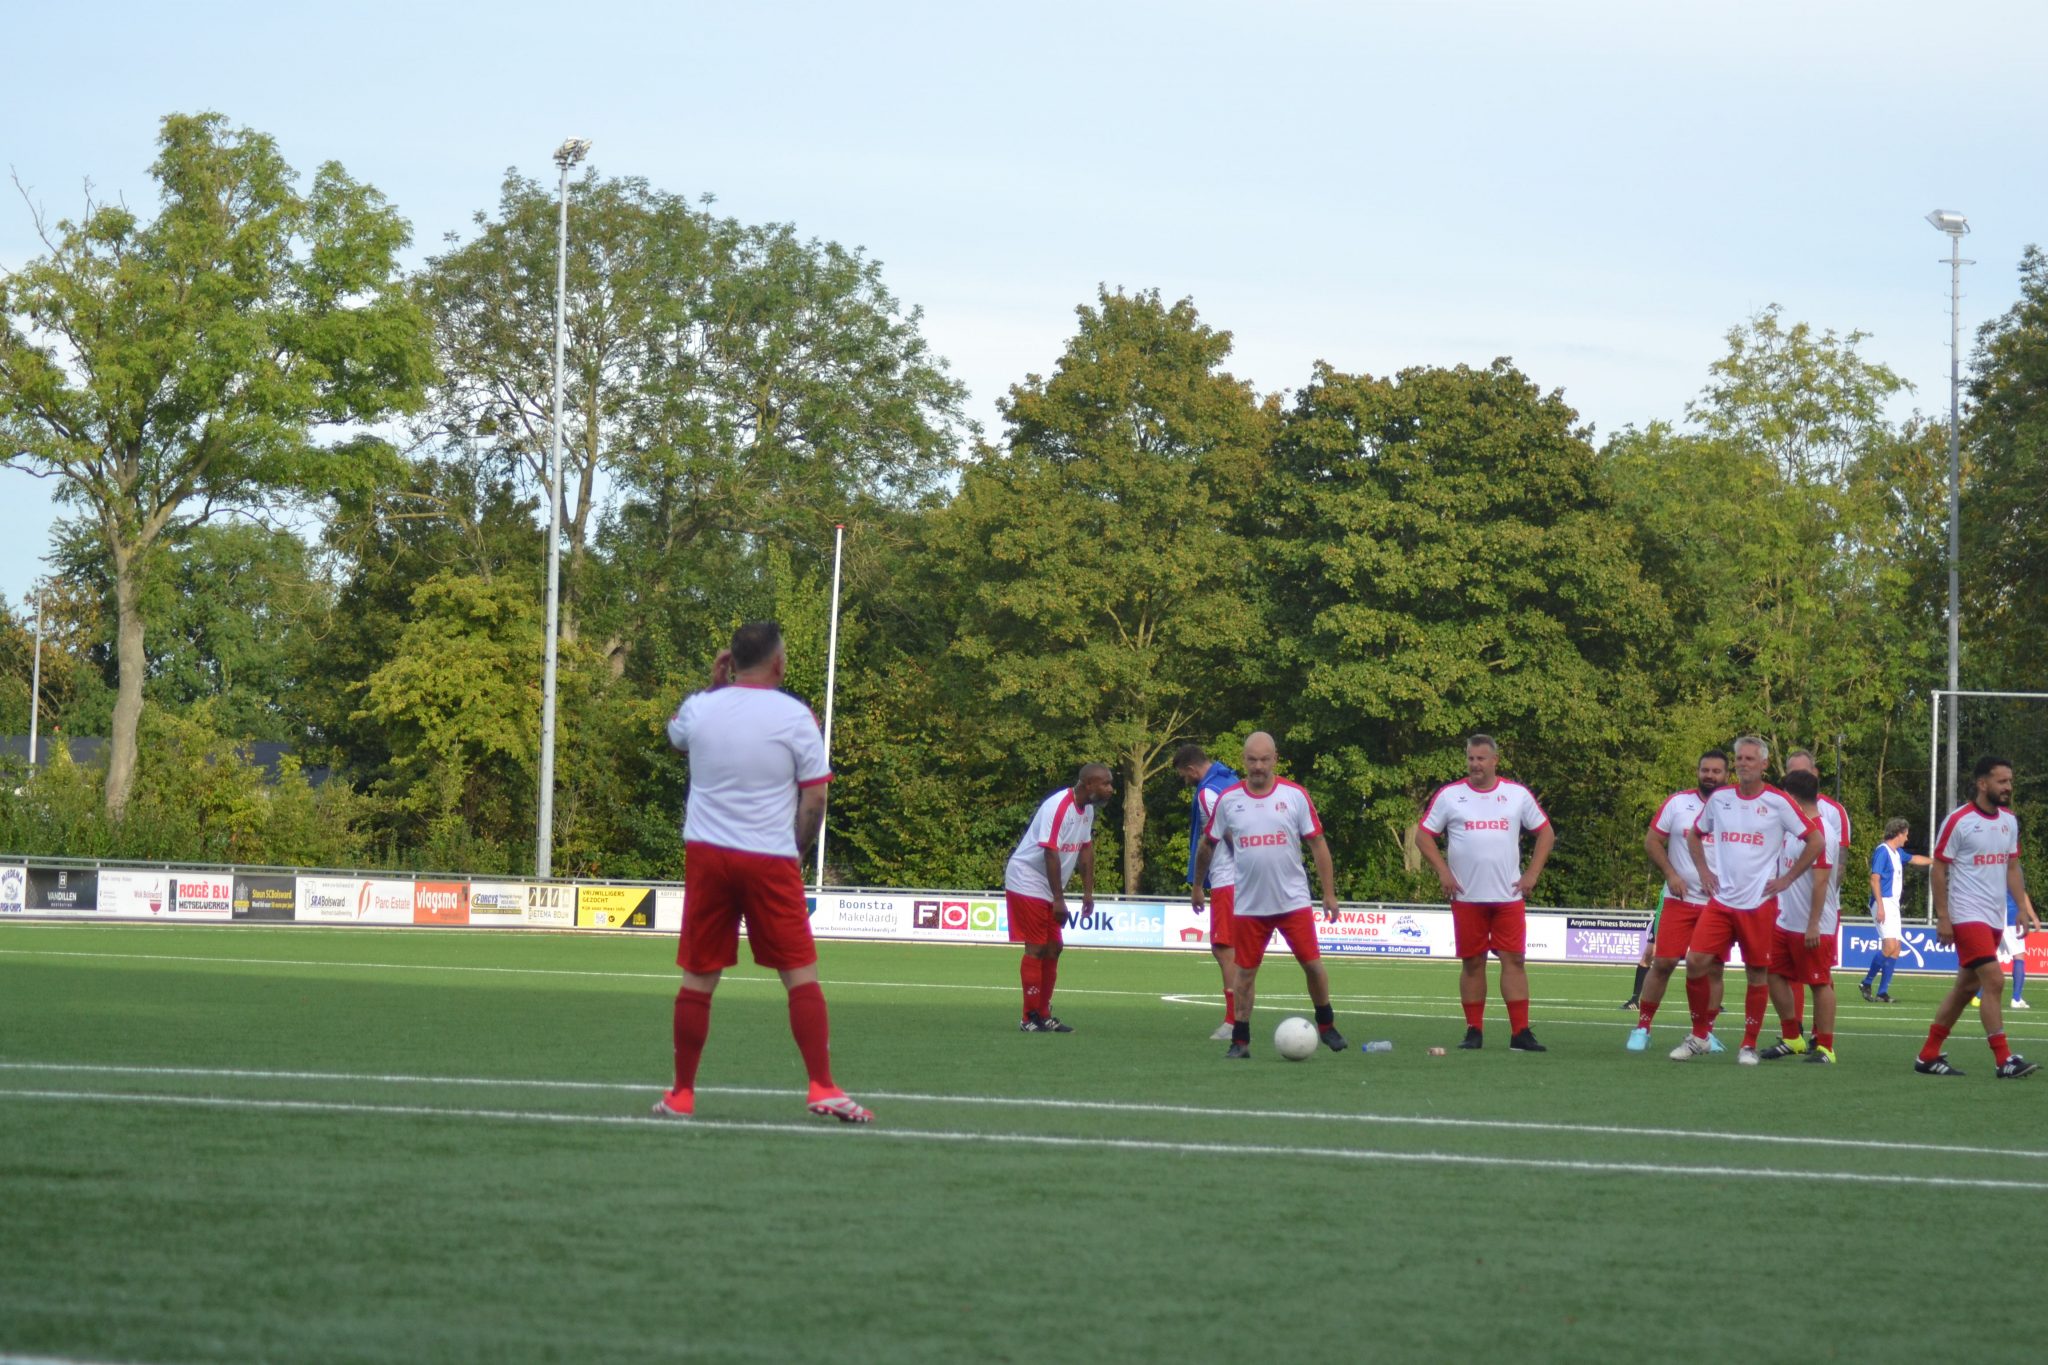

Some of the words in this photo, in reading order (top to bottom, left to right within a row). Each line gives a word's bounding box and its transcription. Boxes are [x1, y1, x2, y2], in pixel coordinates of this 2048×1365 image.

[179, 881, 209, 898] ROGÈ
[416, 886, 458, 914] vlagsma
[839, 899, 893, 911] Boonstra
[838, 912, 898, 926] Makelaardij
[1570, 919, 1596, 929] Anytime
[1597, 920, 1619, 928] Fitness
[1619, 920, 1648, 929] Bolsward
[1319, 926, 1379, 936] BOLSWARD
[1588, 931, 1641, 945] ANYTIME
[1388, 946, 1427, 954] Stofzuigers
[1588, 943, 1641, 955] FITNESS
